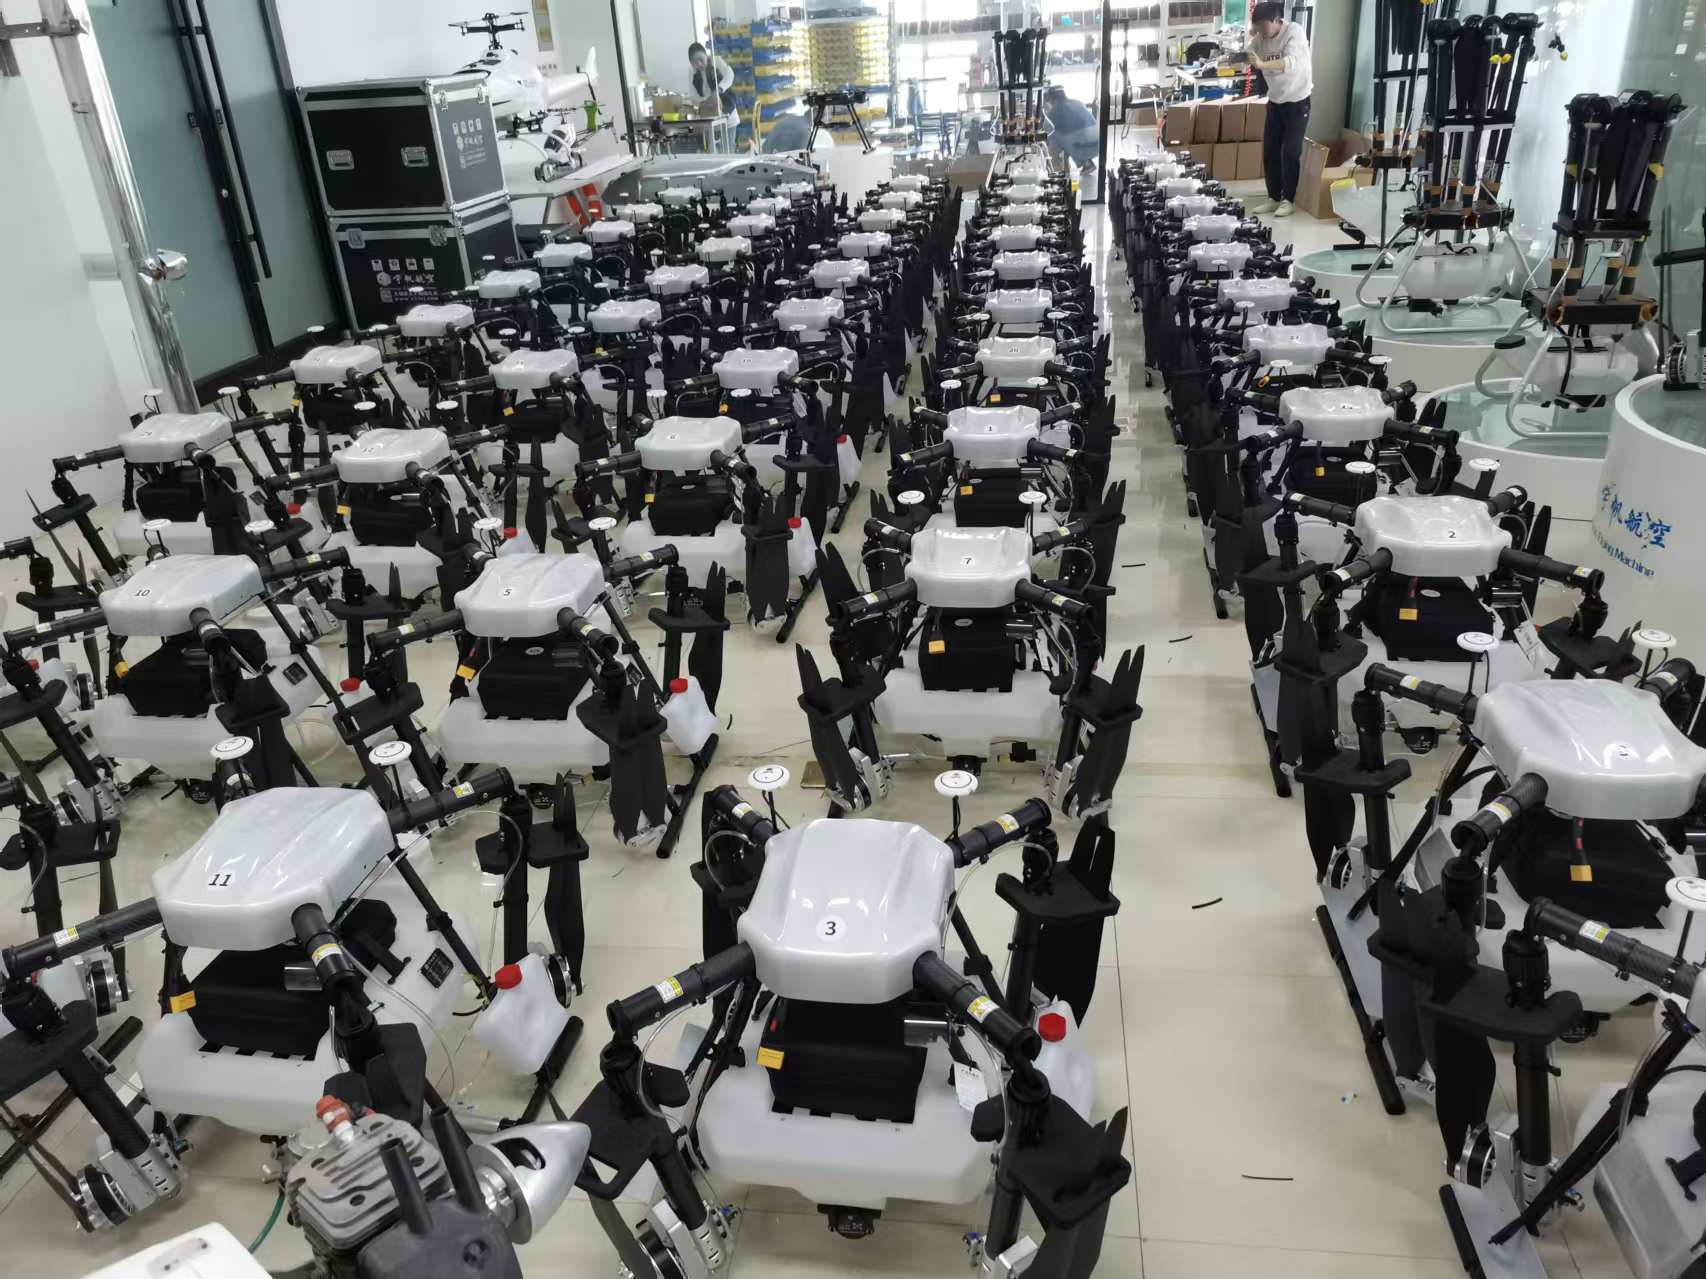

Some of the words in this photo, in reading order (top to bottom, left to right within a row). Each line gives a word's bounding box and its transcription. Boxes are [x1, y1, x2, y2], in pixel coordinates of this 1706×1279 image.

[1448, 530, 1456, 539] 2
[964, 557, 972, 565] 7
[1614, 547, 1655, 577] Machine
[134, 589, 151, 597] 10
[503, 588, 513, 596] 5
[208, 873, 232, 887] 11
[825, 920, 836, 936] 3
